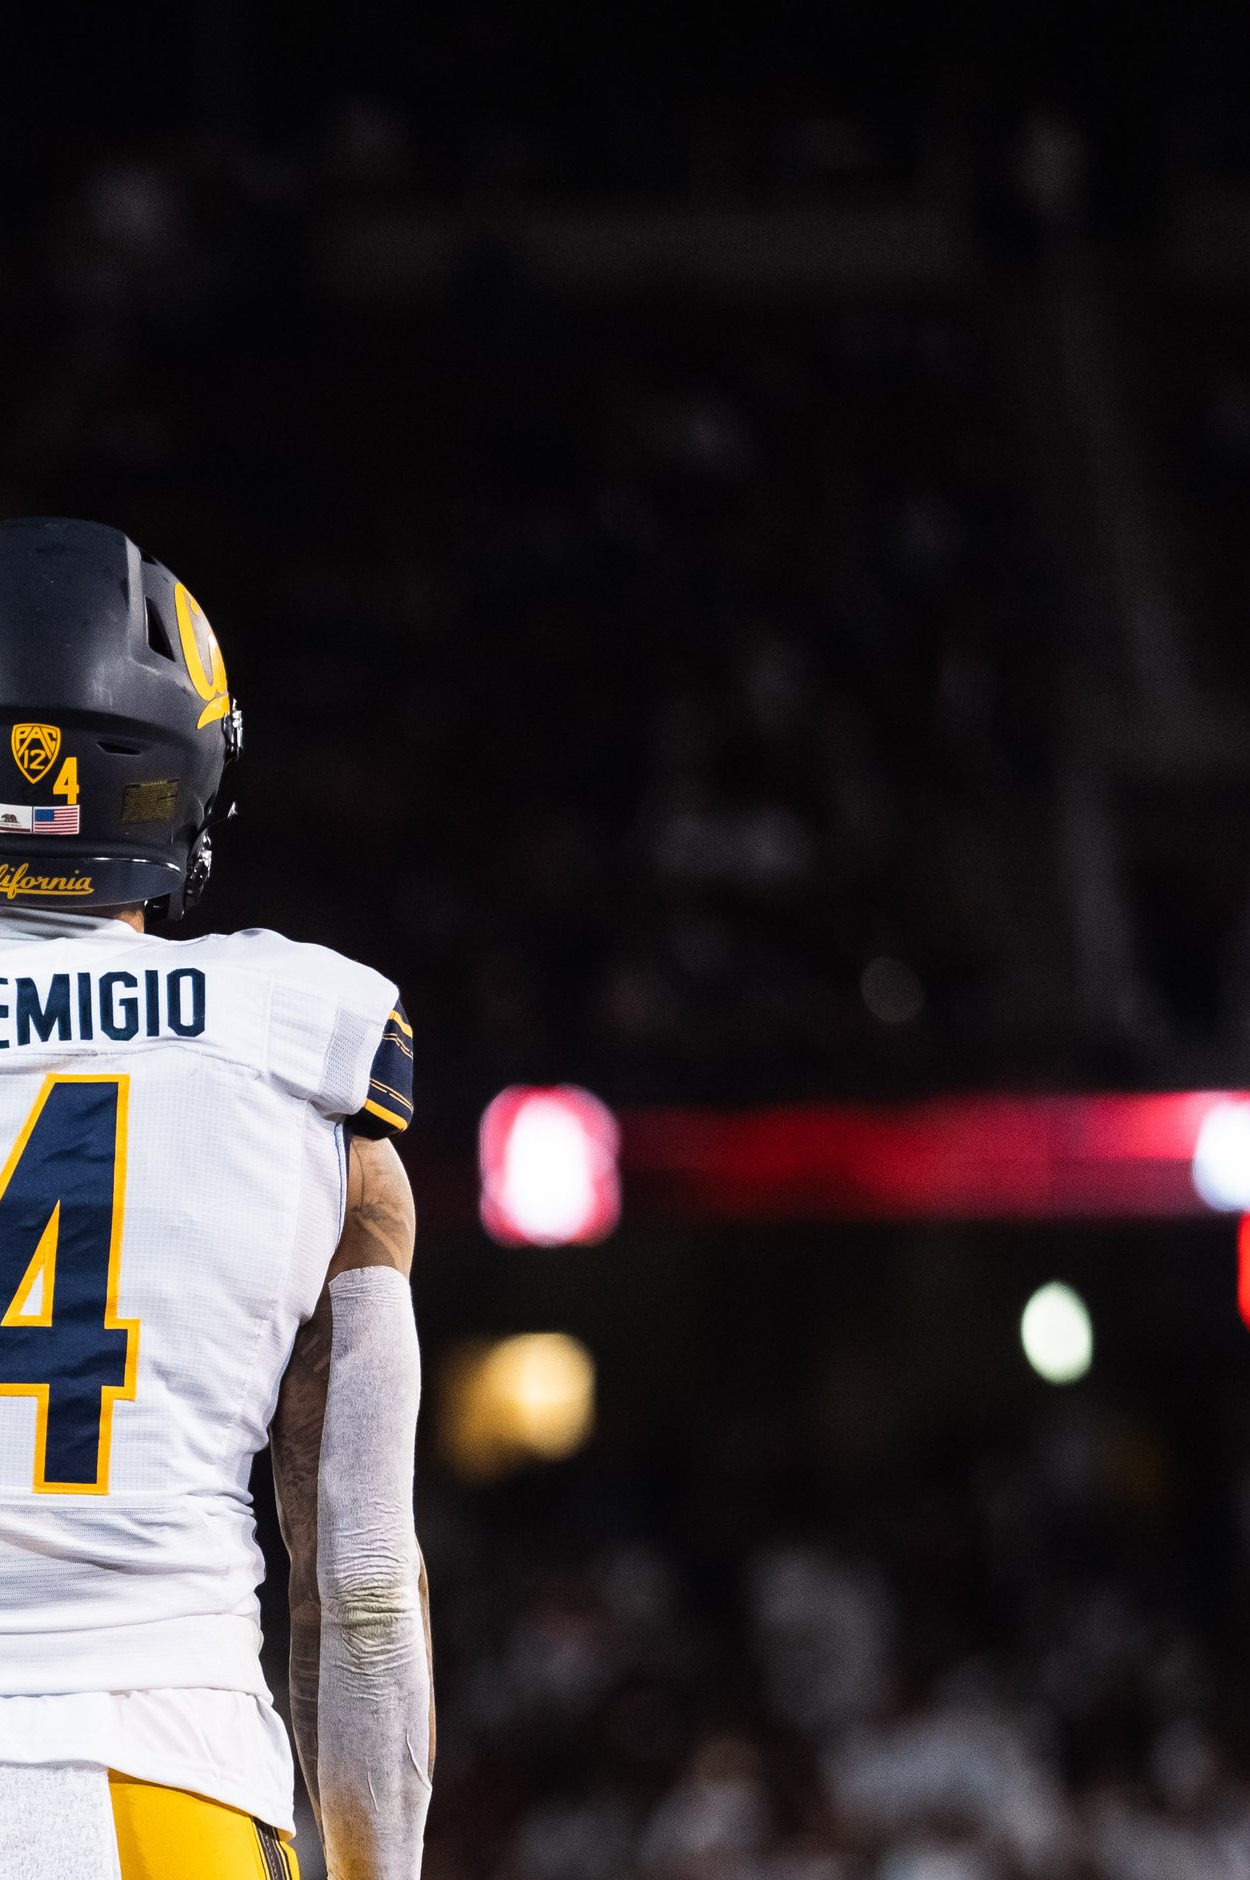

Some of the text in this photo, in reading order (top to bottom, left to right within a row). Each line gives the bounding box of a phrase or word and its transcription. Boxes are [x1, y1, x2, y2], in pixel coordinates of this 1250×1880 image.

[15, 726, 57, 759] PAC
[23, 749, 46, 769] 12
[53, 757, 79, 804] 4
